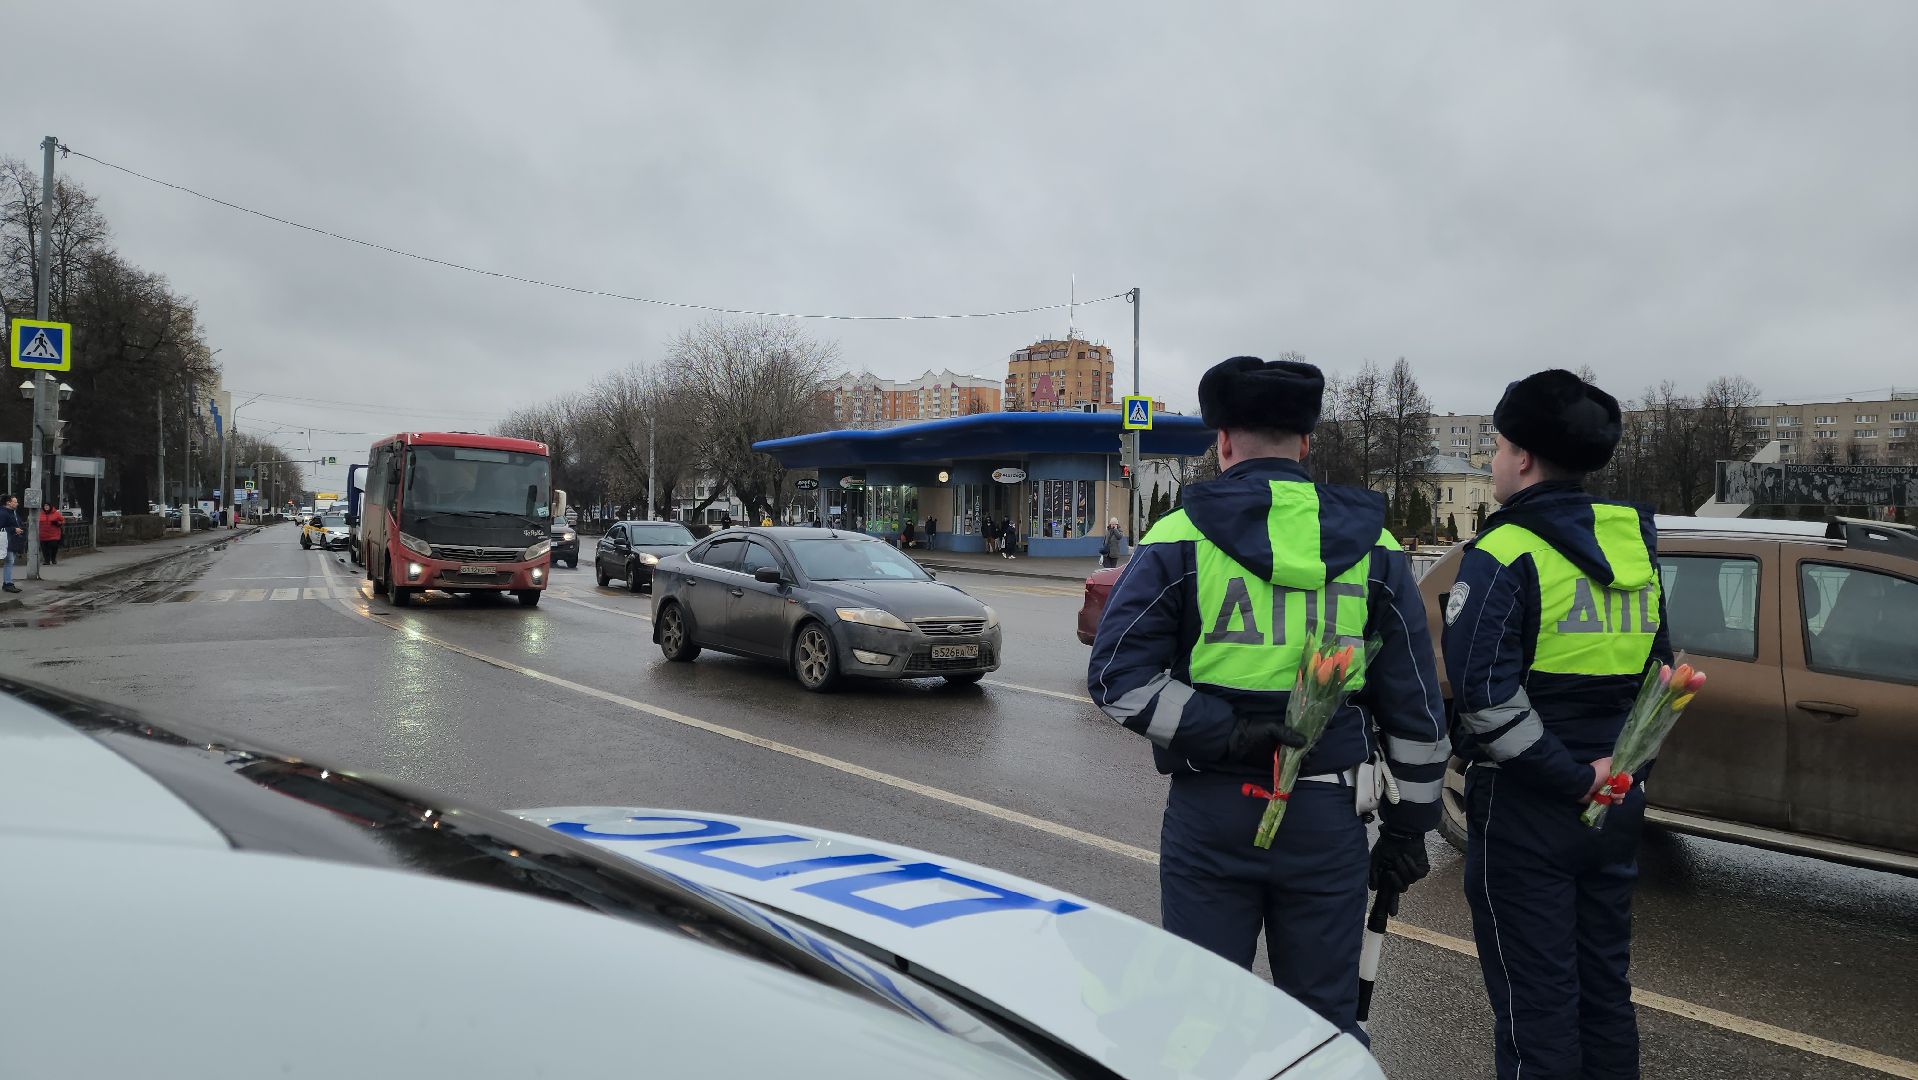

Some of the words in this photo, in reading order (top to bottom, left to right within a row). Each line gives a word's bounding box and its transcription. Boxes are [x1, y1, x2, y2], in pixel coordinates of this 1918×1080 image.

[1787, 465, 1828, 473] ПОДОЛЬСК
[1834, 466, 1863, 474] ГОРОД
[1865, 465, 1913, 474] ТРУДОВОЙ
[549, 816, 1089, 928] ДПС
